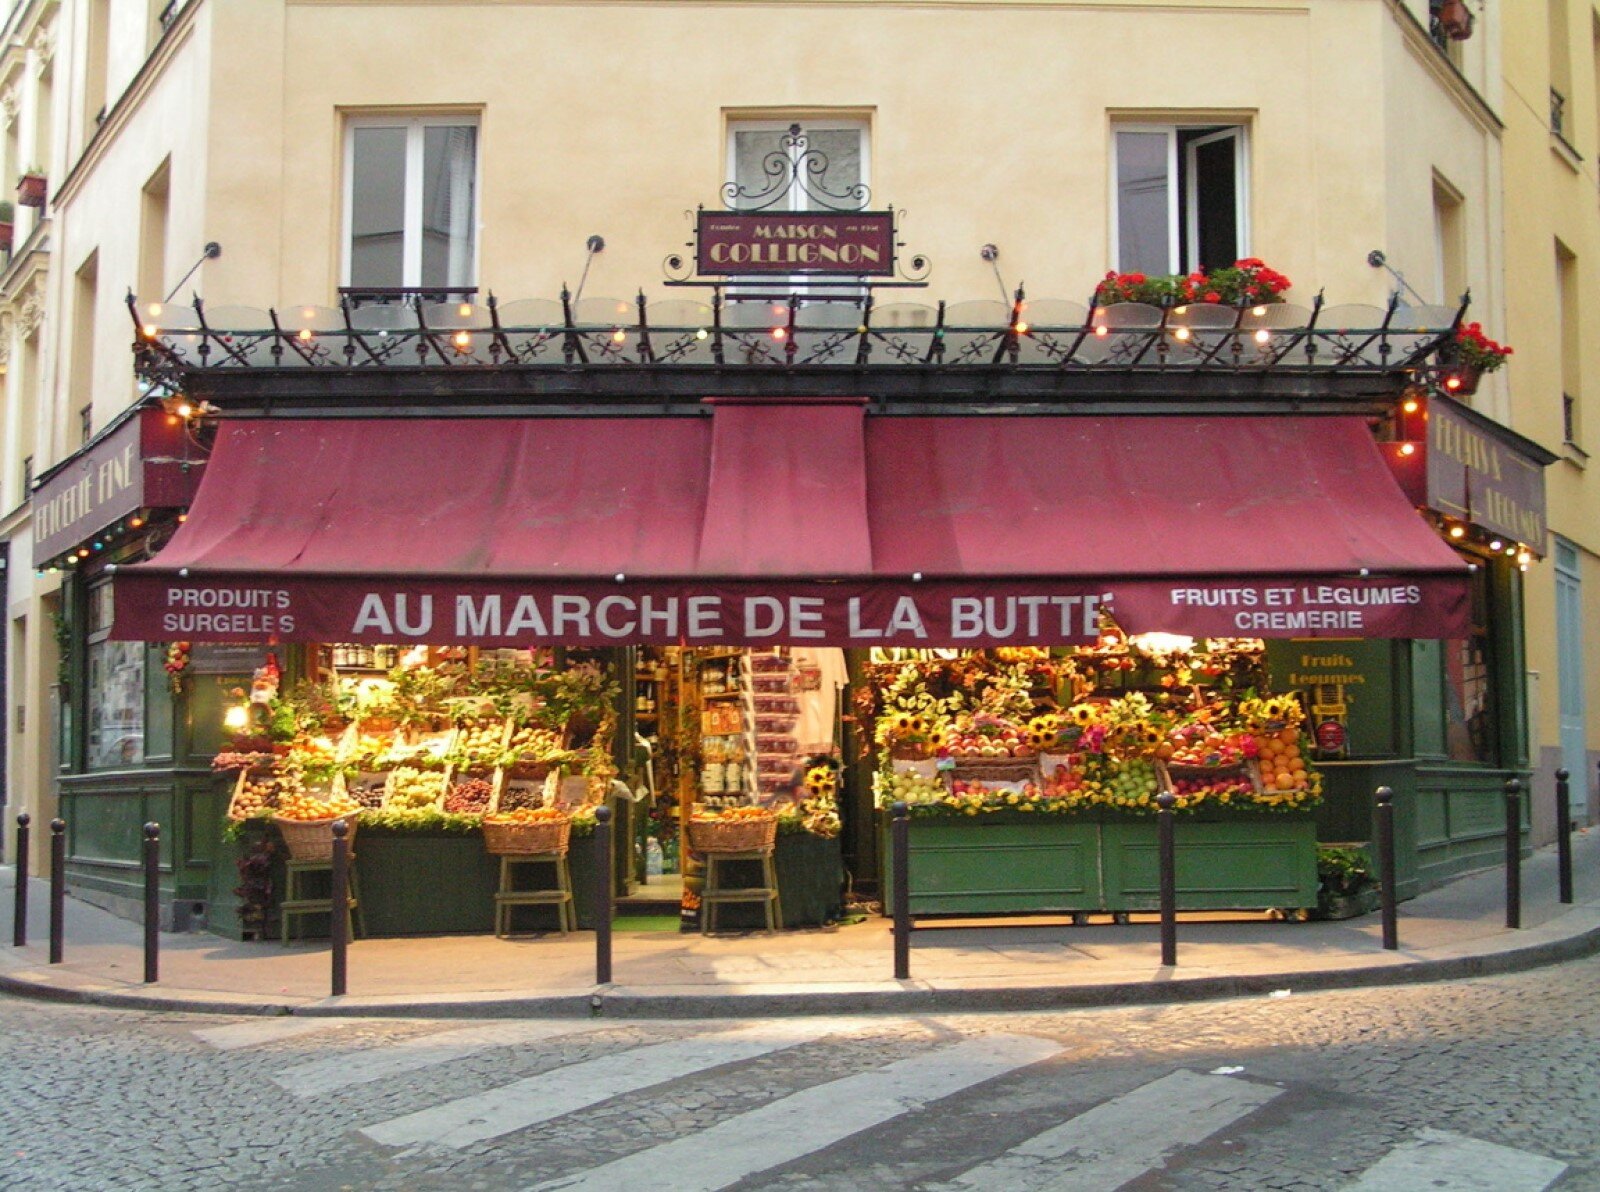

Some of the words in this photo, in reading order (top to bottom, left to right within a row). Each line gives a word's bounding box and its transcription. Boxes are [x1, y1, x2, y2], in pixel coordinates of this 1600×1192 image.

[753, 224, 838, 239] MAISON
[710, 242, 881, 263] COLLIGNON
[168, 588, 291, 609] PRODUITS
[1170, 588, 1258, 606] FRUITS
[1265, 588, 1296, 606] ET
[1302, 585, 1421, 606] LEGUMES
[163, 613, 294, 633] SURGELES
[352, 593, 433, 636] AU
[456, 595, 724, 638] MARCHE
[744, 596, 826, 638] DE
[849, 596, 929, 639] LA
[1235, 611, 1363, 630] CREMERIE
